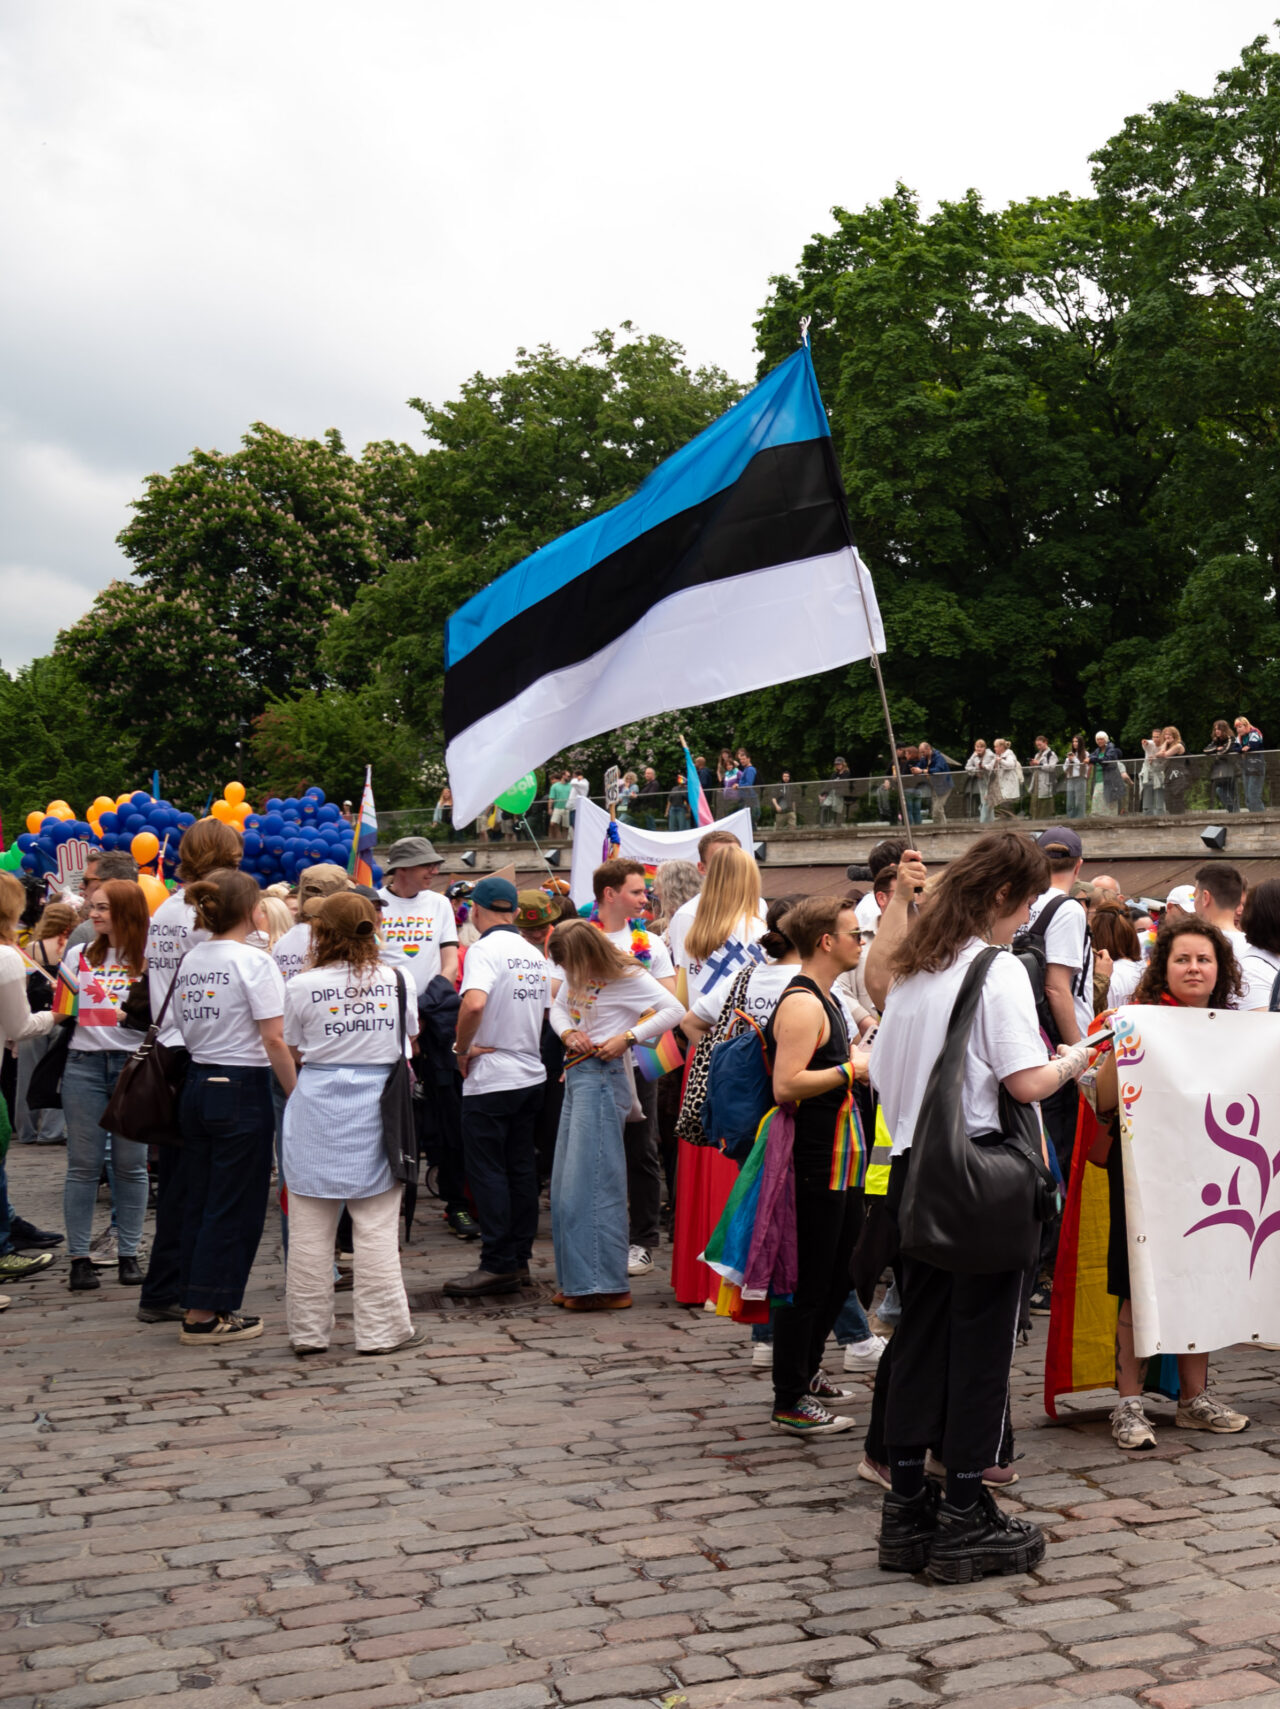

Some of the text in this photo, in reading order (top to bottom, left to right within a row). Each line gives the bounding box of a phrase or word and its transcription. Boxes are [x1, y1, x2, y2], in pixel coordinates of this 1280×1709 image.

[381, 916, 433, 928] HAPPY
[386, 930, 433, 942] PRIDE
[311, 984, 401, 1003] DIPLOMATS
[344, 1002, 375, 1016] FOR
[325, 1018, 395, 1037] EQUALITY
